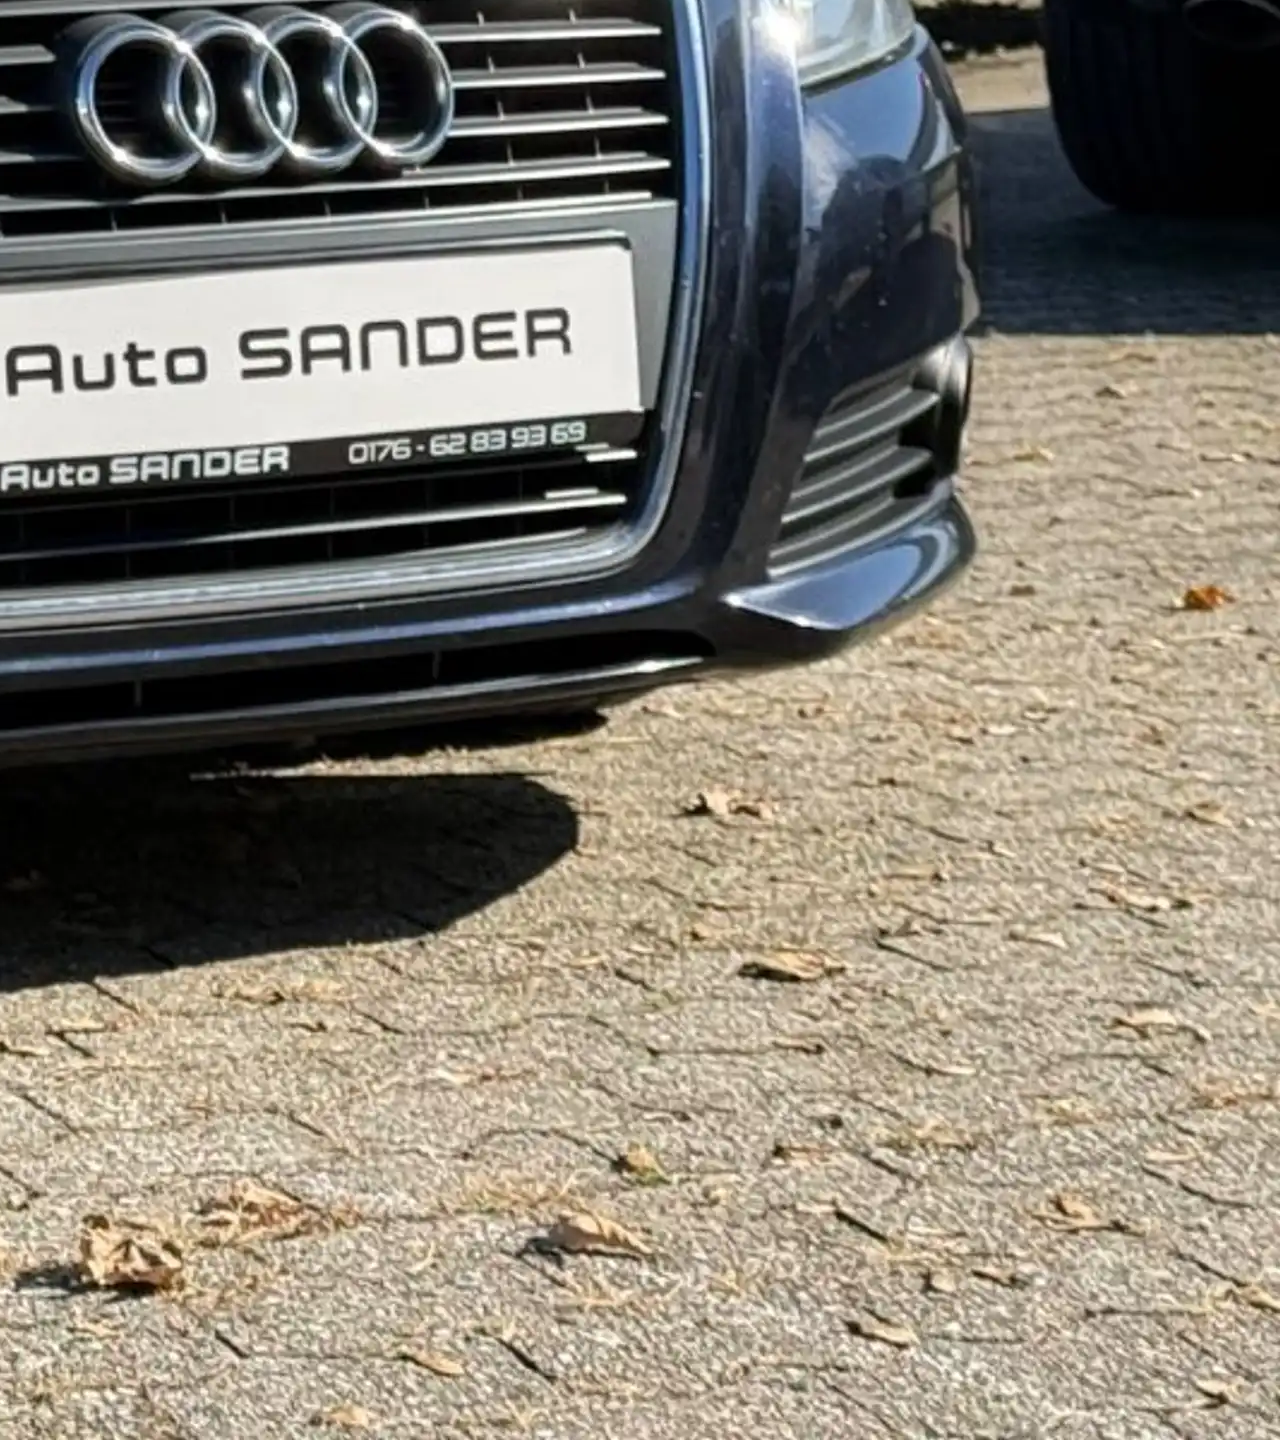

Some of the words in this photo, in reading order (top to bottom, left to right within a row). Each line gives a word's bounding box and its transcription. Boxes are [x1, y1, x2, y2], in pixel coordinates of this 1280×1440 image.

[4, 342, 208, 397] Auto
[237, 306, 572, 380] SANDER
[0, 463, 101, 491] Auto
[109, 444, 290, 484] SANDER
[347, 437, 412, 464] 0176
[430, 432, 467, 457] 62
[471, 428, 507, 453] 83
[511, 424, 547, 449] 93
[550, 420, 587, 445] 69
